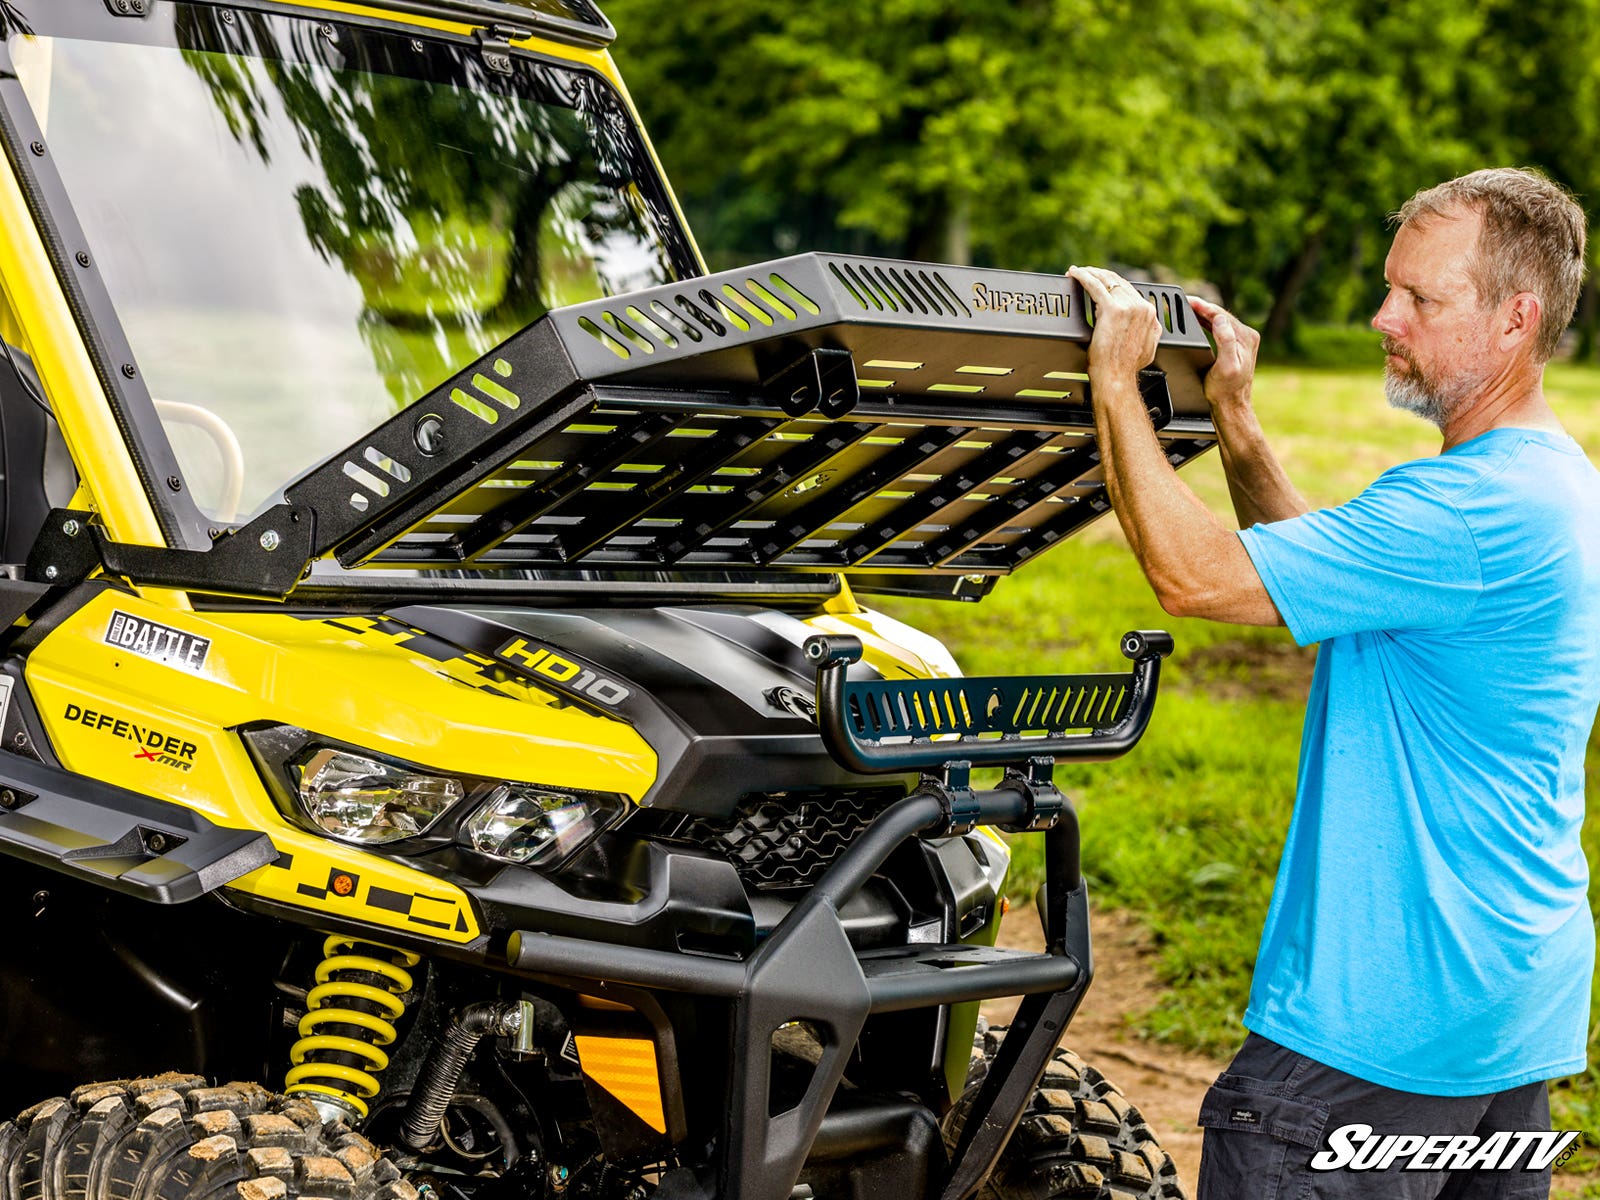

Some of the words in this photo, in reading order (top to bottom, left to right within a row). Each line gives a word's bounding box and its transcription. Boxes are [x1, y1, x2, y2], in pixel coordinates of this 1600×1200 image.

[971, 282, 1070, 318] SUPERATV
[120, 617, 205, 669] BATTLE
[500, 638, 630, 706] HD10
[64, 703, 198, 761] DEFENDER
